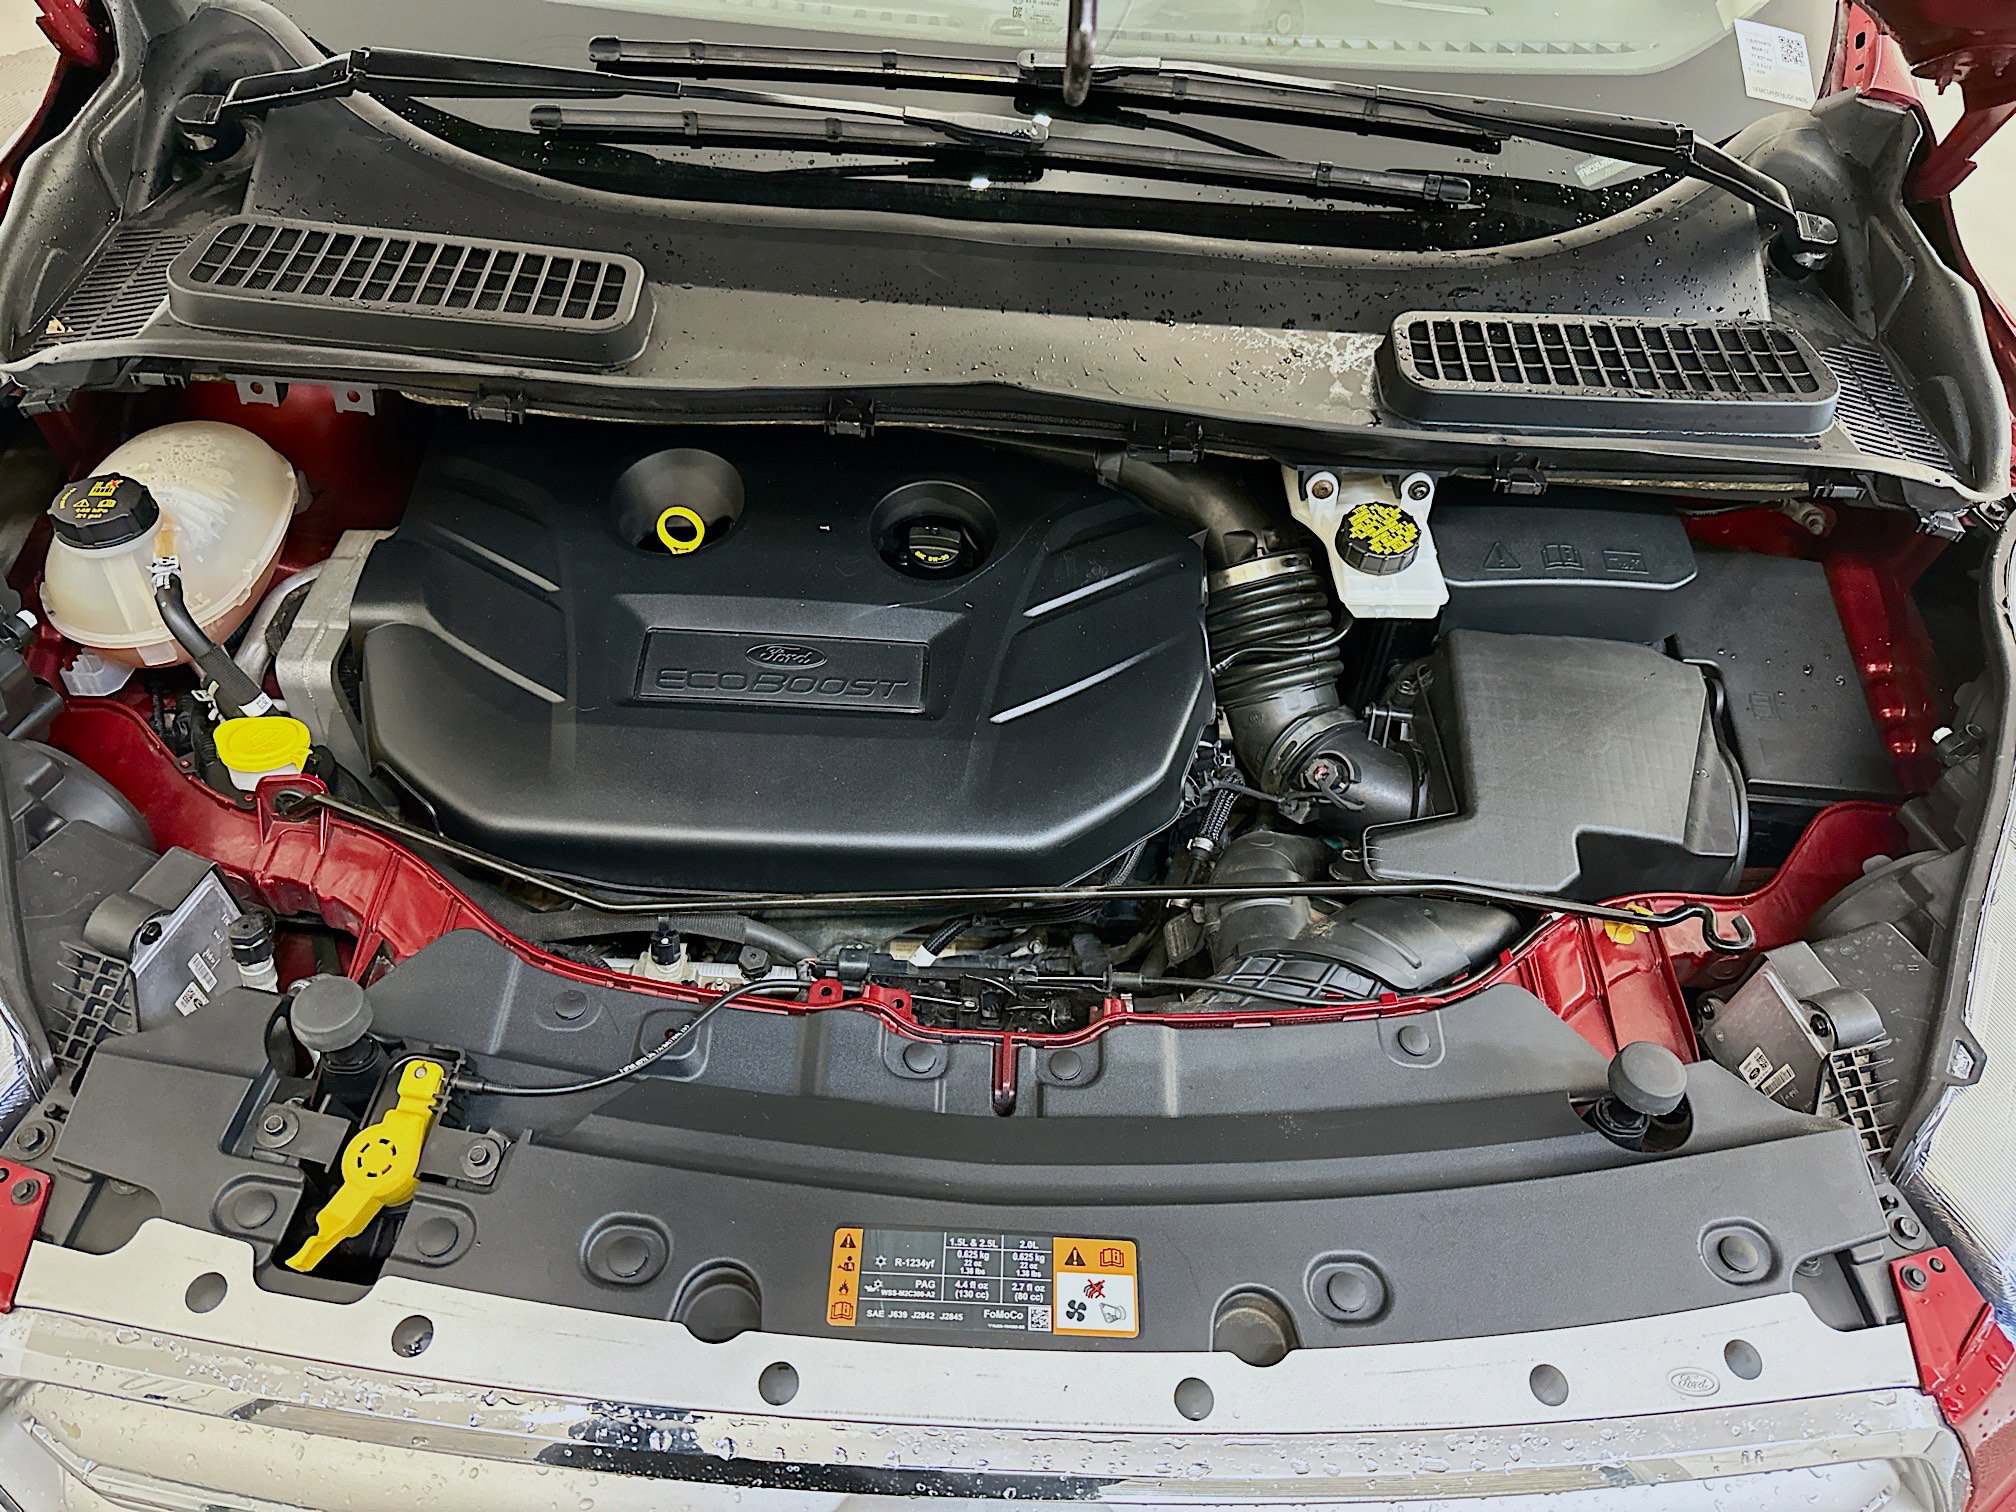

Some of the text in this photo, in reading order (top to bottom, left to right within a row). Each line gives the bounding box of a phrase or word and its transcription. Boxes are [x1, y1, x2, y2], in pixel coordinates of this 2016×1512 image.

[655, 667, 909, 699] ECOBOOST
[949, 1237, 999, 1248] 1.5L & 2.5L
[1019, 1240, 1039, 1249] 2.0L
[956, 1249, 990, 1261] 0.625 kg
[1034, 1253, 1045, 1264] kg
[894, 1258, 936, 1270] R-1234yf
[963, 1259, 973, 1267] 22
[915, 1280, 936, 1289] PAG
[954, 1280, 989, 1290] 4.4 fl oz
[1011, 1282, 1046, 1292] 2.7 fl oz
[954, 1289, 990, 1301] (130 cc)
[1029, 1292, 1044, 1303] cc)
[866, 1309, 885, 1318] SAE
[888, 1310, 908, 1319] J639
[983, 1309, 1024, 1320] FoMoCo
